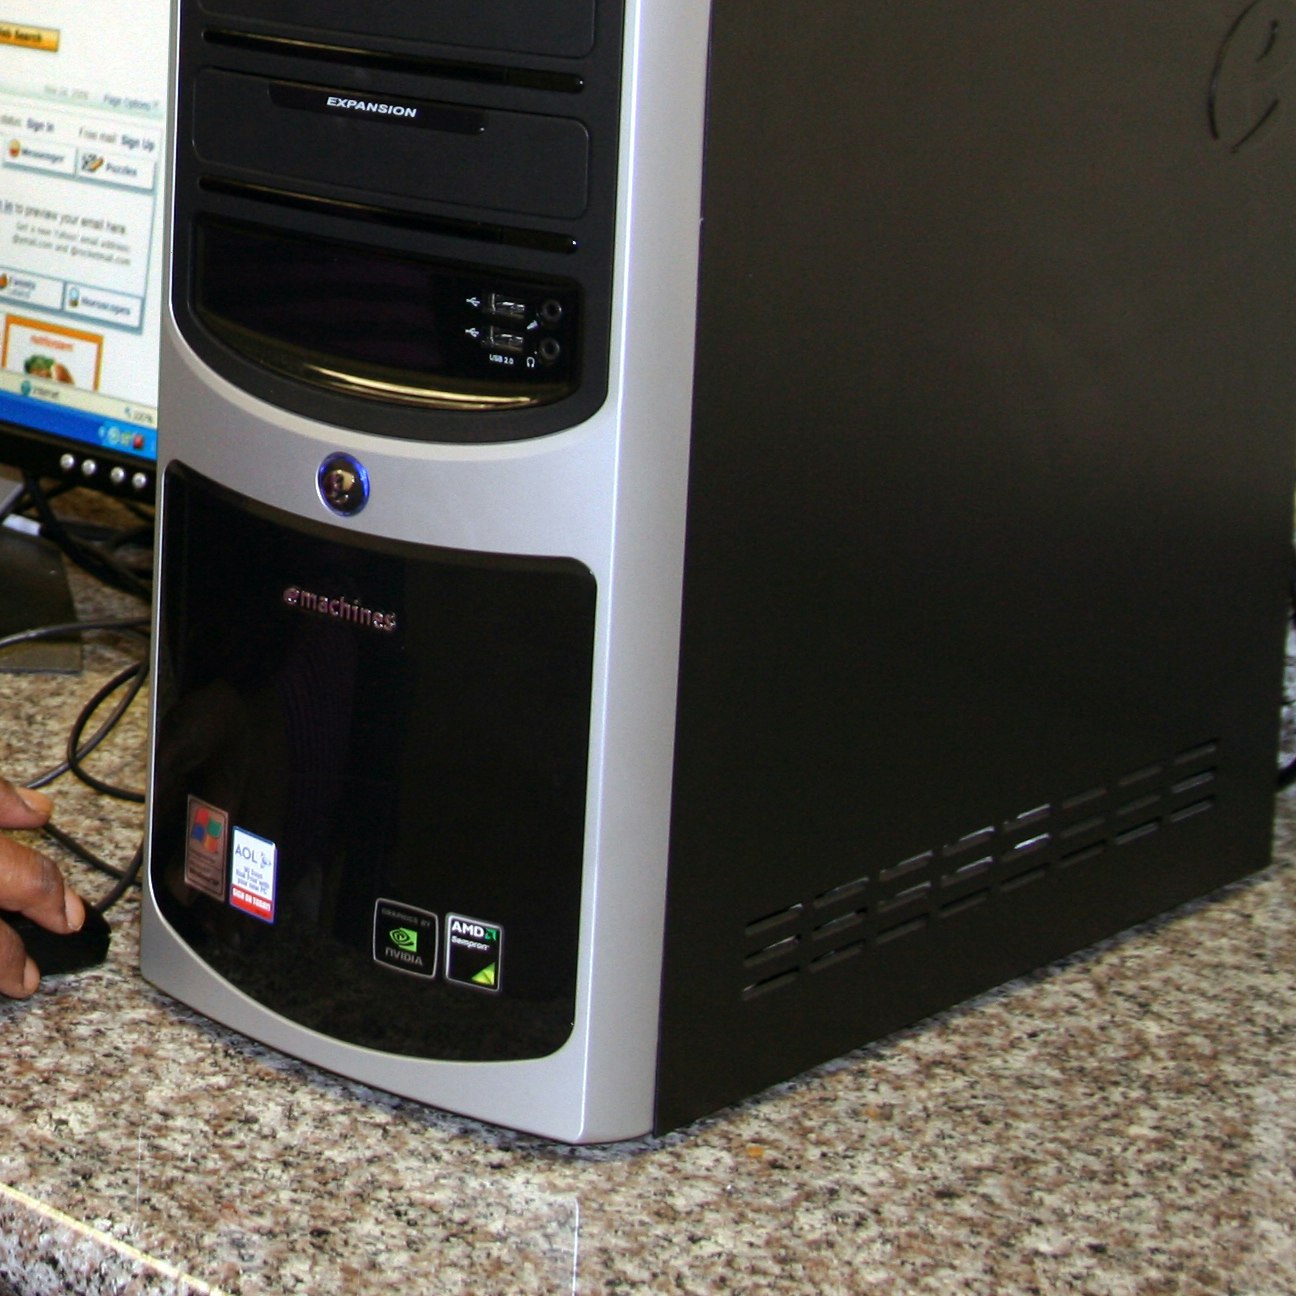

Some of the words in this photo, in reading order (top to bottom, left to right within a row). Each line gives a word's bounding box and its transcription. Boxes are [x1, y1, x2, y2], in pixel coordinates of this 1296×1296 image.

[326, 95, 417, 119] EXPANSION
[283, 586, 397, 632] emachines
[235, 843, 257, 864] AOL
[452, 920, 484, 938] AMD
